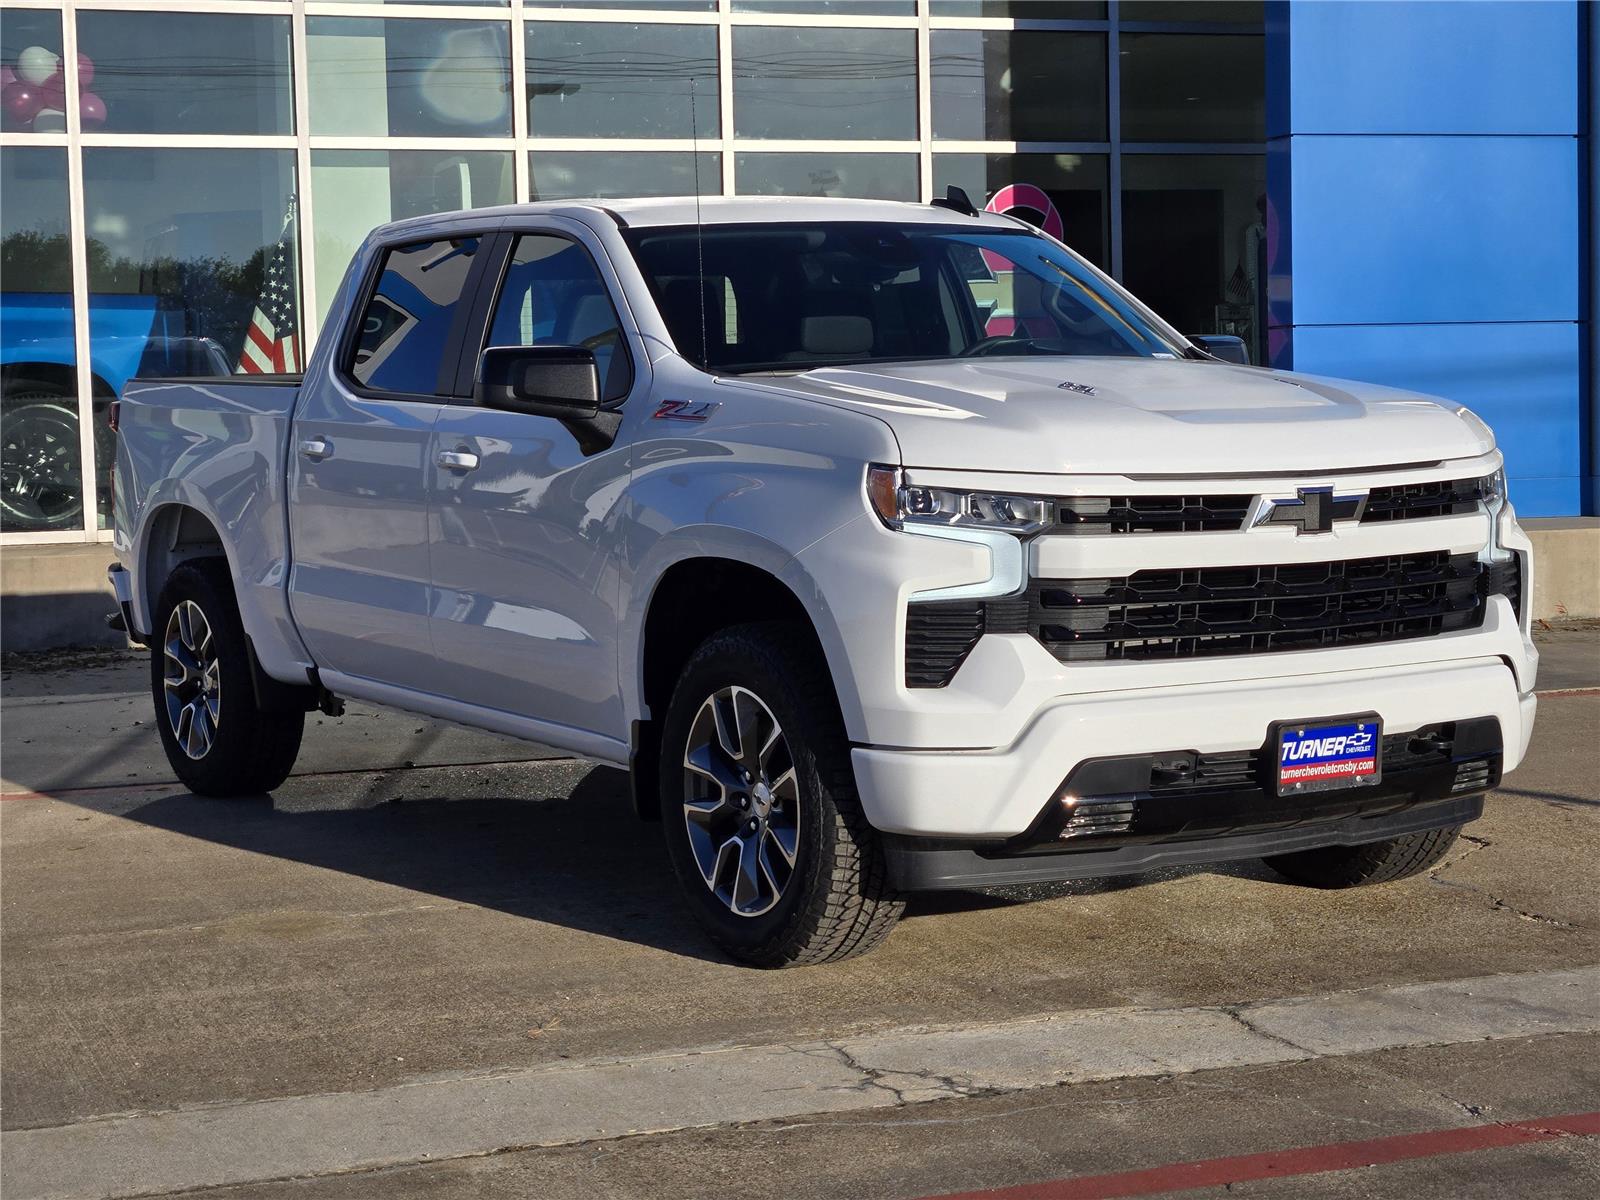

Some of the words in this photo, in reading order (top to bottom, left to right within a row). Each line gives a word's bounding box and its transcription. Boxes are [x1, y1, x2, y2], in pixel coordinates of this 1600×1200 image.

[1282, 736, 1347, 761] TURNER
[1345, 745, 1371, 754] CHEVROLET
[1280, 760, 1374, 780] turnerchevroletcrosby.com
